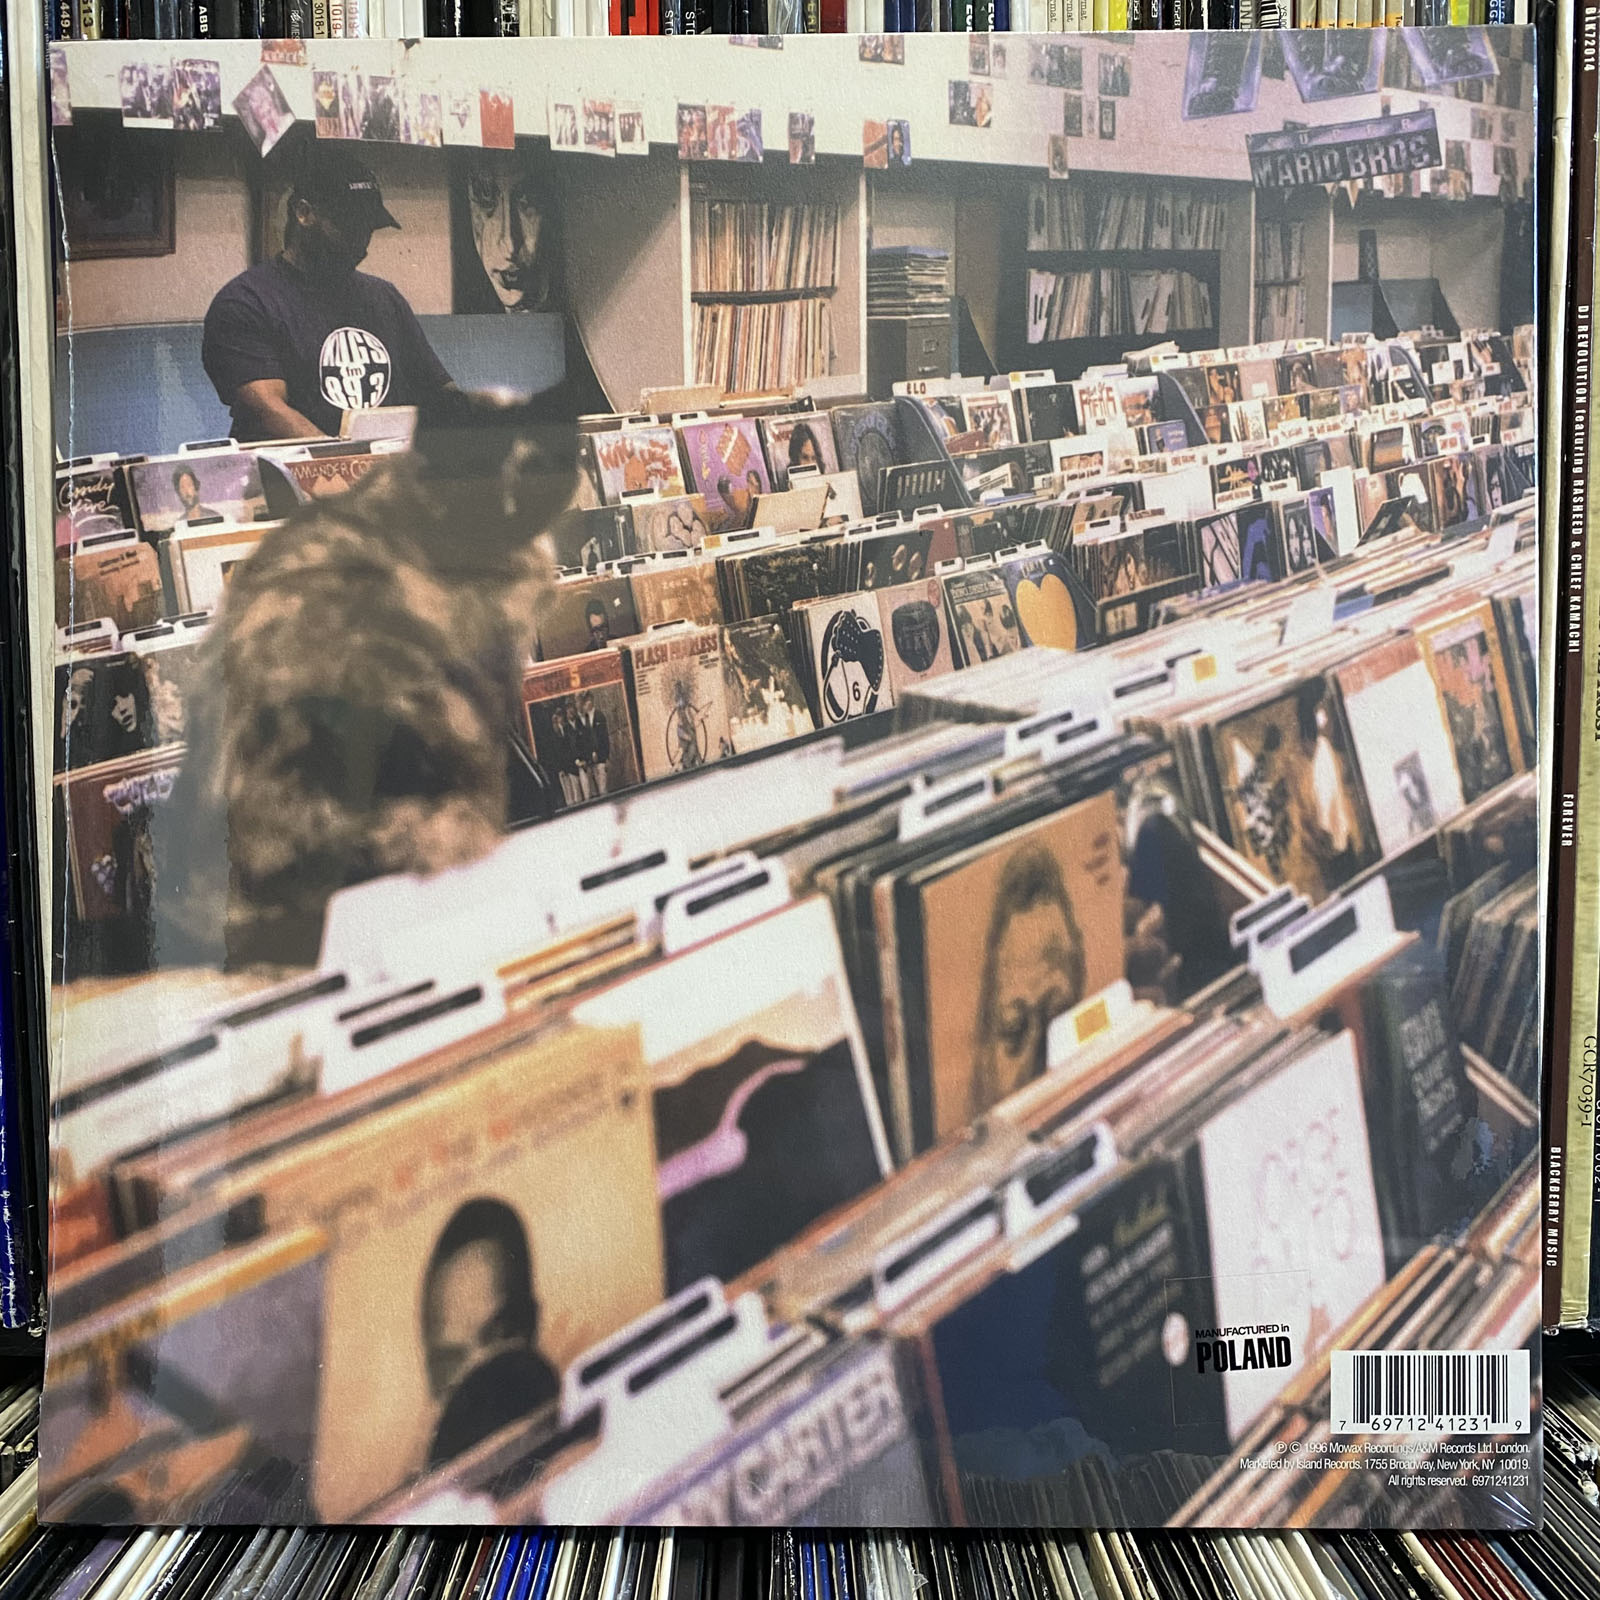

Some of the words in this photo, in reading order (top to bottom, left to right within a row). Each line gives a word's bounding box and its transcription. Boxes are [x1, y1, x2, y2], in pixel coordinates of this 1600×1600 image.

[199, 5, 209, 33] ABB
[313, 2, 325, 36] 3018-1
[1583, 7, 1597, 71] BLK72014
[1254, 150, 1343, 187] MARIO
[1577, 304, 1589, 319] DJ
[1575, 325, 1589, 404] REVOLUTION
[1572, 409, 1587, 474] featuring
[1571, 479, 1585, 535] RASHEED
[1571, 541, 1581, 549] &
[1570, 554, 1582, 590] CHIEF
[1568, 596, 1581, 653] KAMACHI
[852, 681, 862, 702] 6
[1561, 794, 1574, 846] FOREVER
[1577, 1035, 1597, 1127] GCR7039-1
[1547, 1147, 1561, 1222] BLACKBERRY
[1546, 1228, 1559, 1267] MUSIC
[1195, 1325, 1279, 1338] MANUFACTURED
[1280, 1323, 1290, 1333] in
[1196, 1335, 1292, 1374] POLAND
[1339, 1420, 1346, 1431] 7
[1371, 1417, 1427, 1432] 69712
[1435, 1417, 1490, 1432] 41231
[1515, 1420, 1522, 1431] 9
[1240, 1458, 1282, 1470] Marketed
[1283, 1458, 1295, 1472] by
[1296, 1458, 1322, 1470] Island
[1364, 1459, 1388, 1470] 1755
[1389, 1458, 1436, 1472] Broadway,
[1437, 1458, 1455, 1470] New
[1455, 1458, 1480, 1472] York,
[1482, 1459, 1495, 1470] NY
[1500, 1459, 1531, 1470] 10019.
[1304, 1442, 1328, 1453] 1996
[1329, 1442, 1362, 1453] Mowax
[1440, 1442, 1476, 1453] Records
[1477, 1442, 1494, 1453] Ltd.
[1495, 1442, 1531, 1453] London.
[1388, 1475, 1400, 1486] All
[1401, 1475, 1426, 1489] rights
[1427, 1475, 1468, 1486] reserved.
[1472, 1475, 1530, 1486] 6971241231
